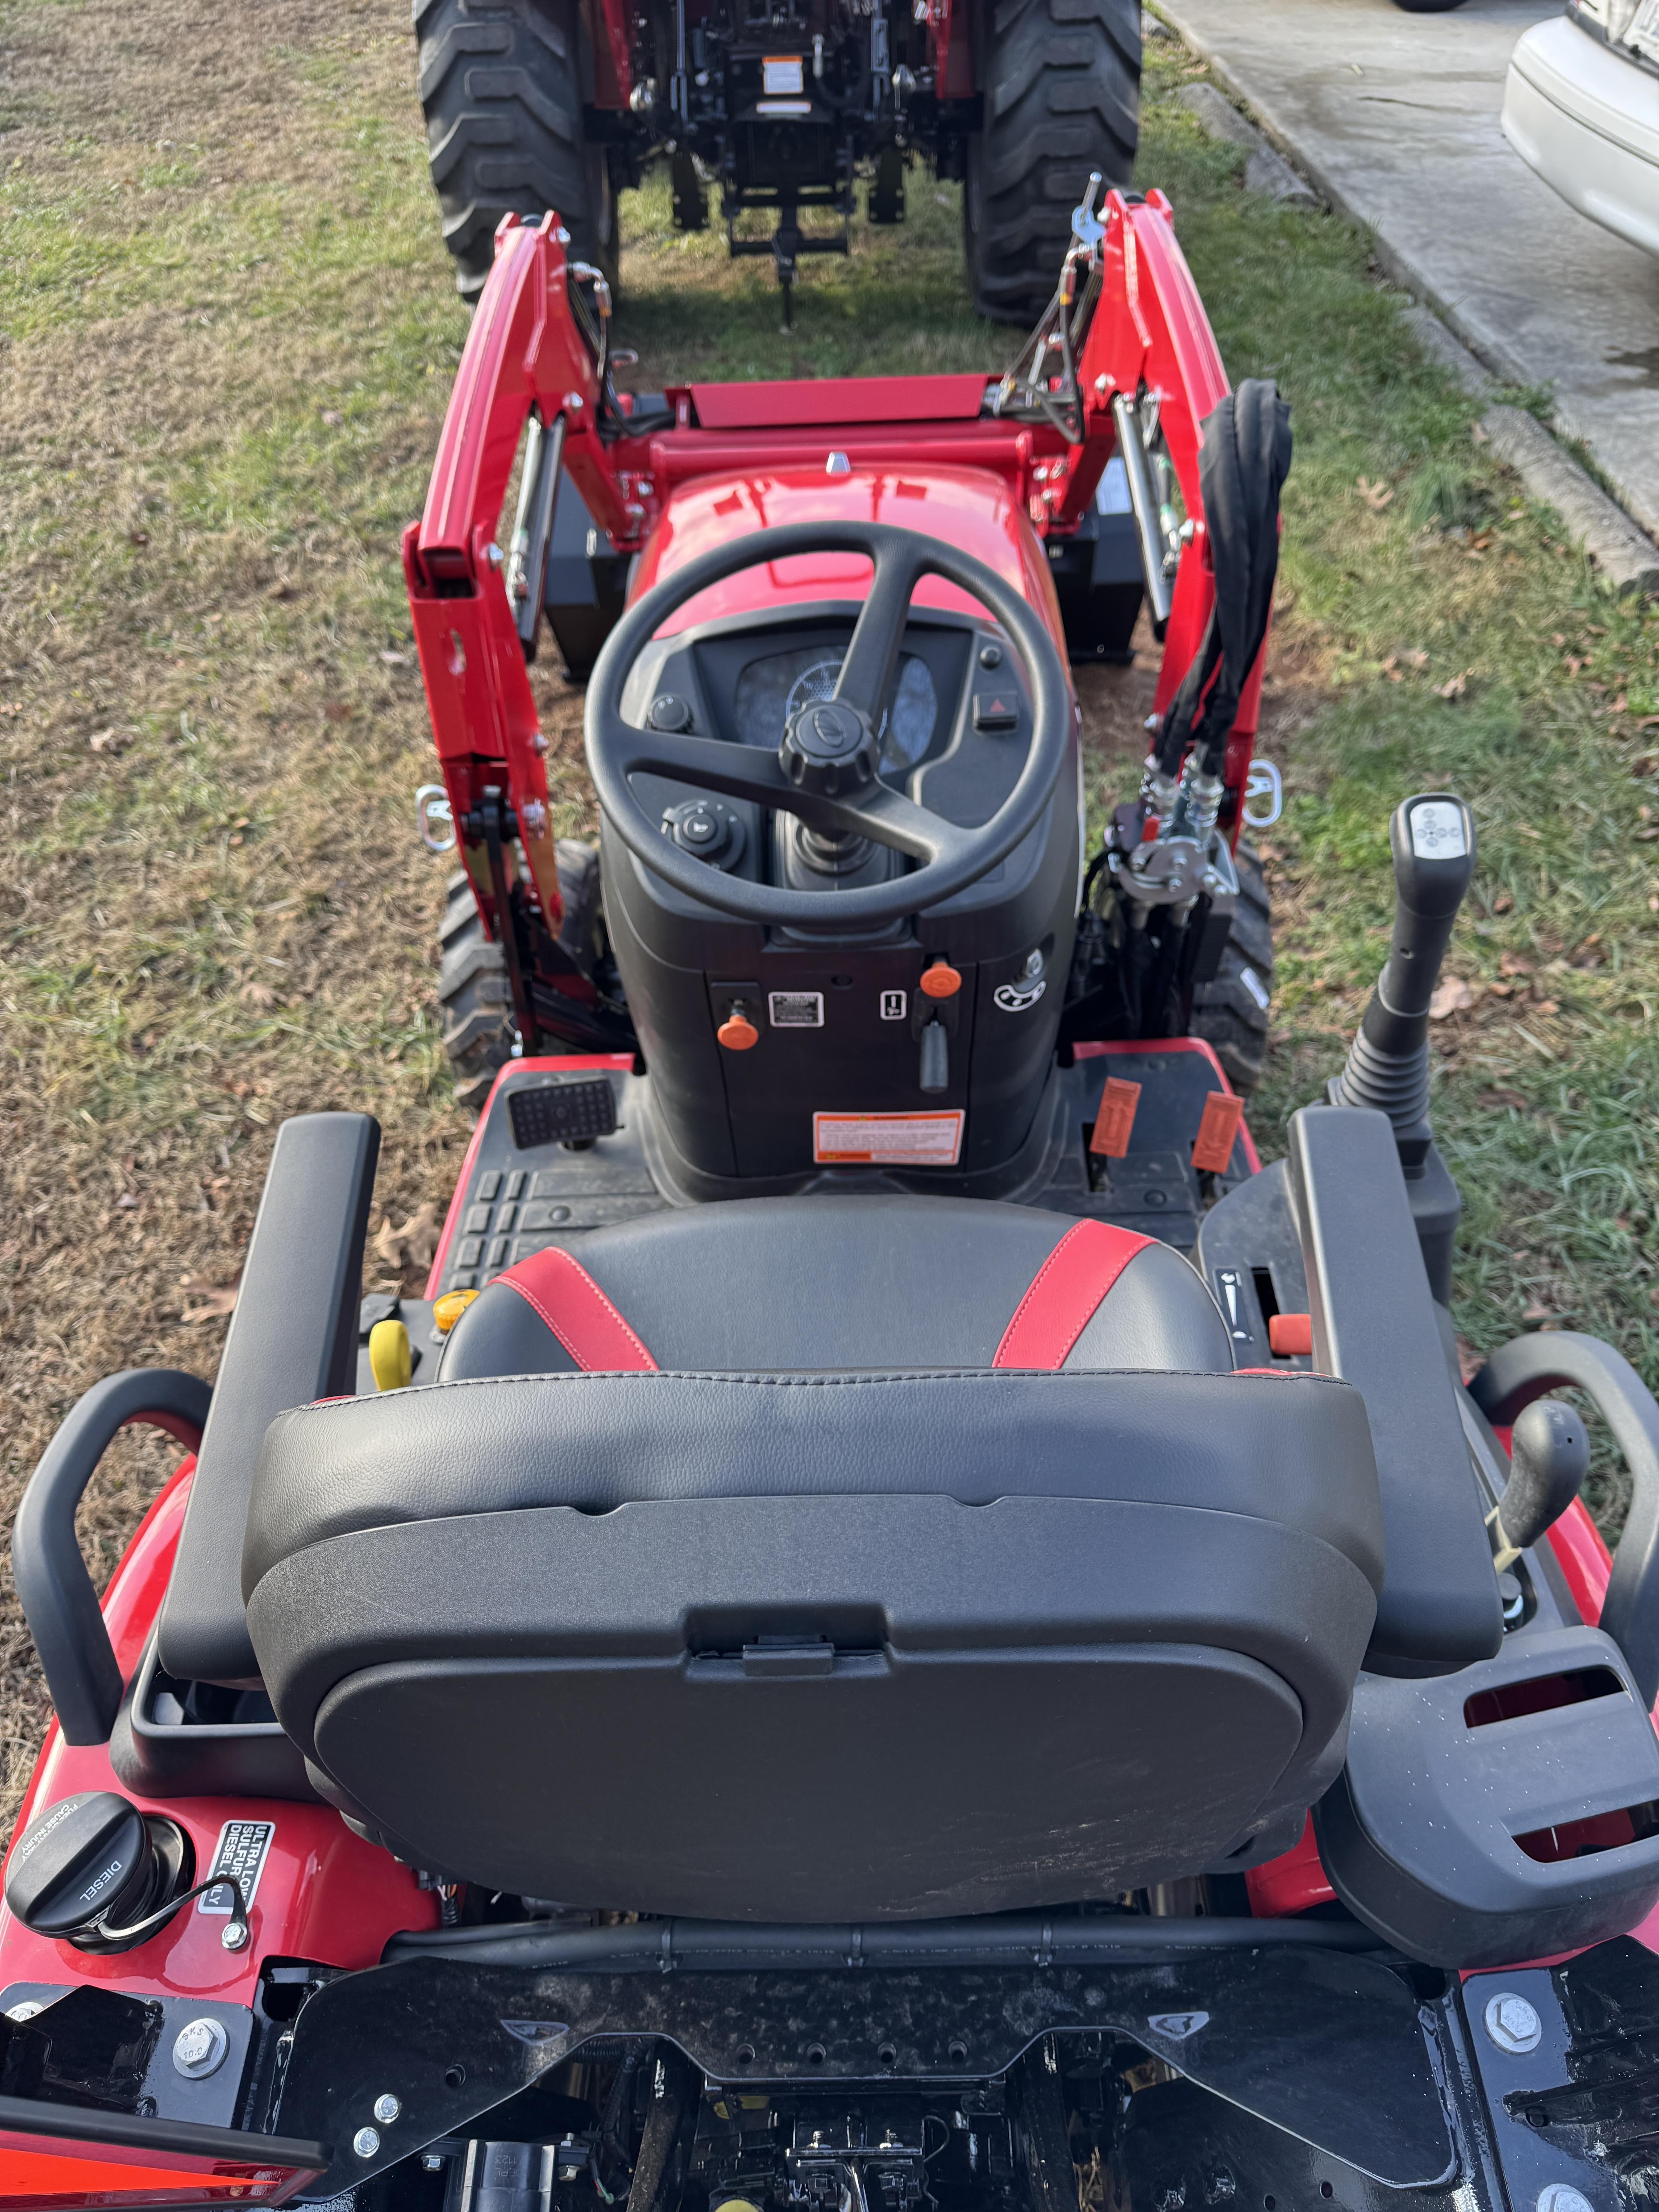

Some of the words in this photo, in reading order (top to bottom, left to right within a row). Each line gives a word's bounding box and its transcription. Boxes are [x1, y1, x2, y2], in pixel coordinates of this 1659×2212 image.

[45, 1804, 70, 1829] CAUSE
[22, 1827, 46, 1853] INJURY
[219, 1825, 242, 1868] DIESEL
[229, 1825, 254, 1876] SULFUR
[245, 1826, 267, 1867] ULTRA
[79, 1860, 122, 1901] DIESEL
[182, 2027, 203, 2040] SKS
